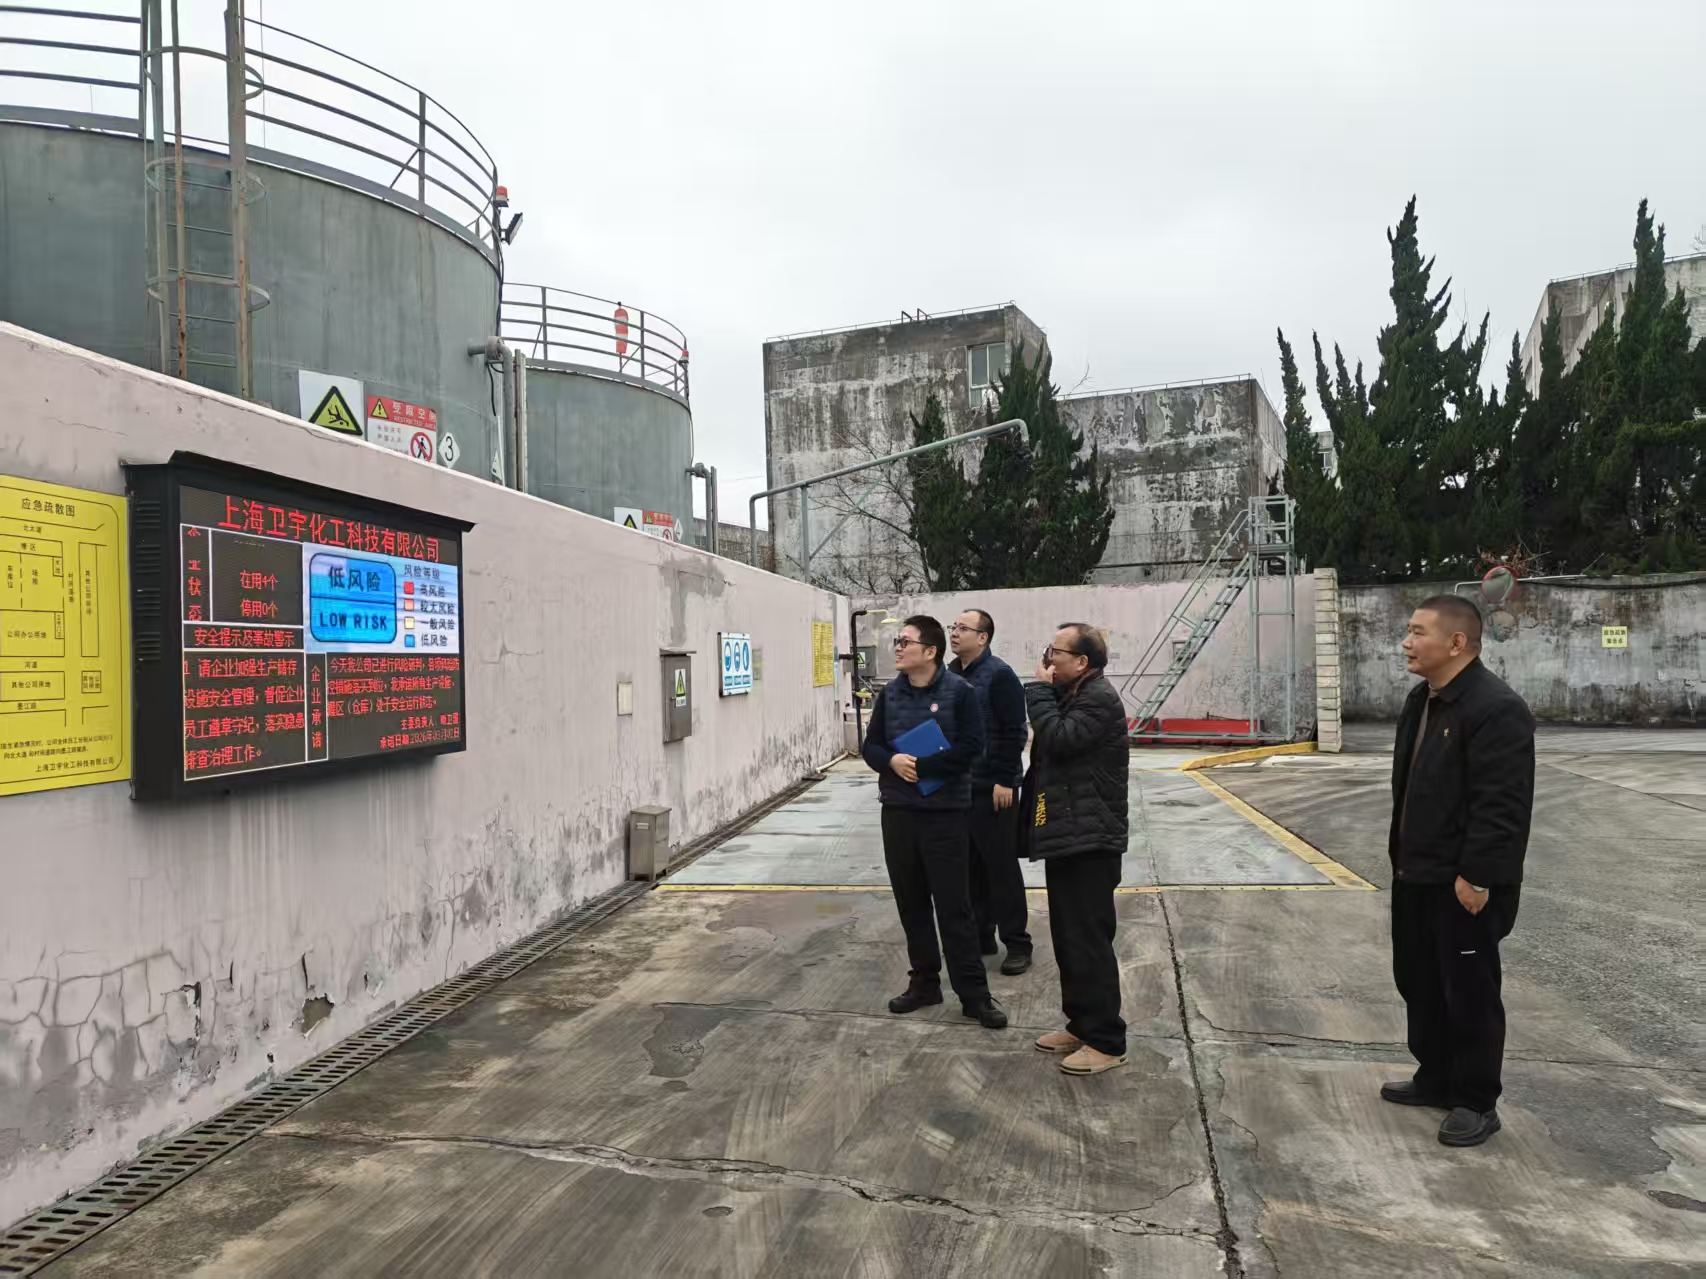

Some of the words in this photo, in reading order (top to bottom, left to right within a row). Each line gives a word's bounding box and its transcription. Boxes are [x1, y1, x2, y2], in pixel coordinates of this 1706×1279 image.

[444, 436, 454, 462] 3
[21, 497, 76, 517] 应急疏散图
[217, 494, 440, 563] 上海卫宇化工科技有限公司
[239, 570, 279, 592] 在用4个
[328, 564, 381, 592] 低风险
[404, 564, 440, 581] 风险等级
[419, 584, 446, 598] 高风险
[239, 599, 279, 618] 停用0个
[319, 612, 347, 628] LOW
[353, 614, 388, 631] RISK
[193, 627, 295, 648] 安全提示及事故警示
[420, 633, 448, 647] 低风险
[311, 664, 322, 748] 企业承诺
[184, 743, 262, 771] 排查治理工作。
